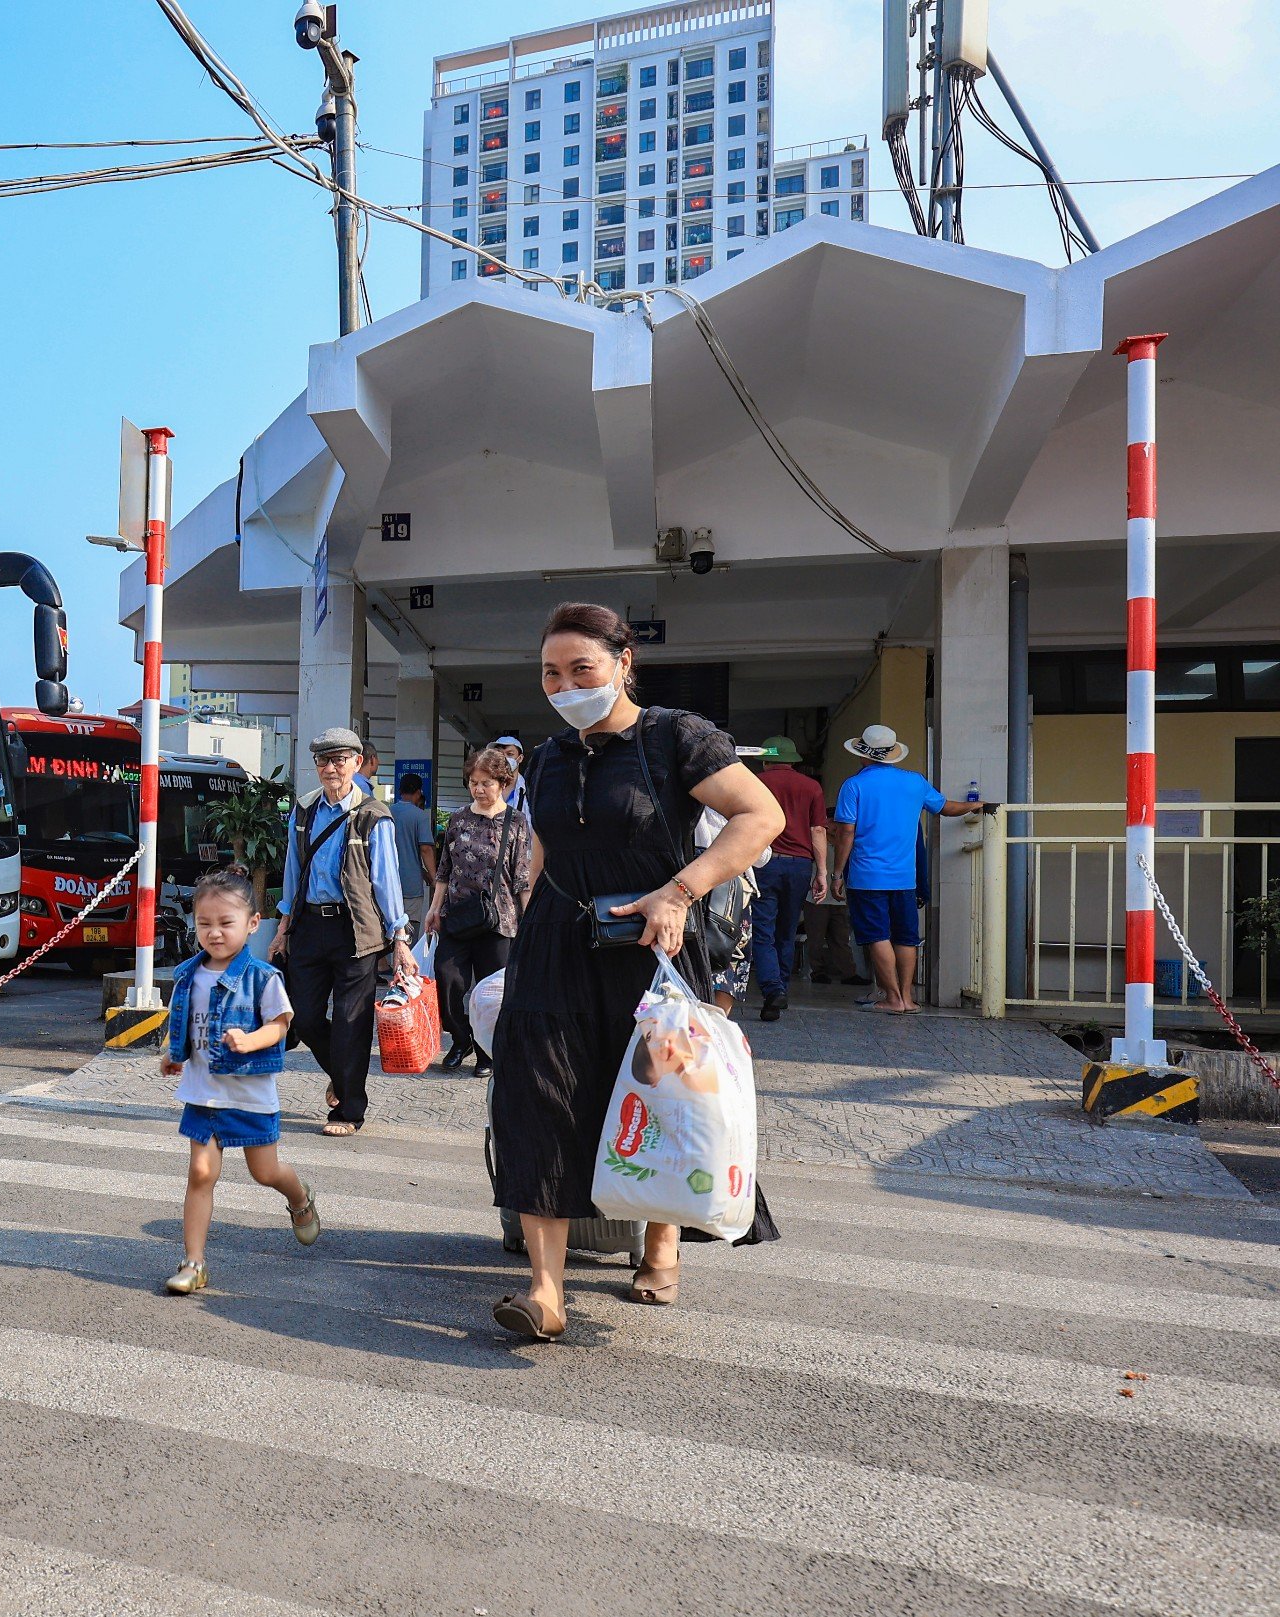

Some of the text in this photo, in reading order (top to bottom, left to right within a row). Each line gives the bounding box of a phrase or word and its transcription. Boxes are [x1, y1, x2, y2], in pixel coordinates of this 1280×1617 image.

[388, 523, 408, 538] 19
[415, 594, 431, 607] 18
[468, 690, 480, 700] 17
[66, 723, 94, 735] VIP
[51, 758, 98, 779] ĐỊNH
[173, 775, 193, 790] ĐỊNH
[208, 776, 225, 792] GIÁP
[54, 876, 97, 897] ĐOÀN
[620, 1099, 642, 1152] HUGGIES
